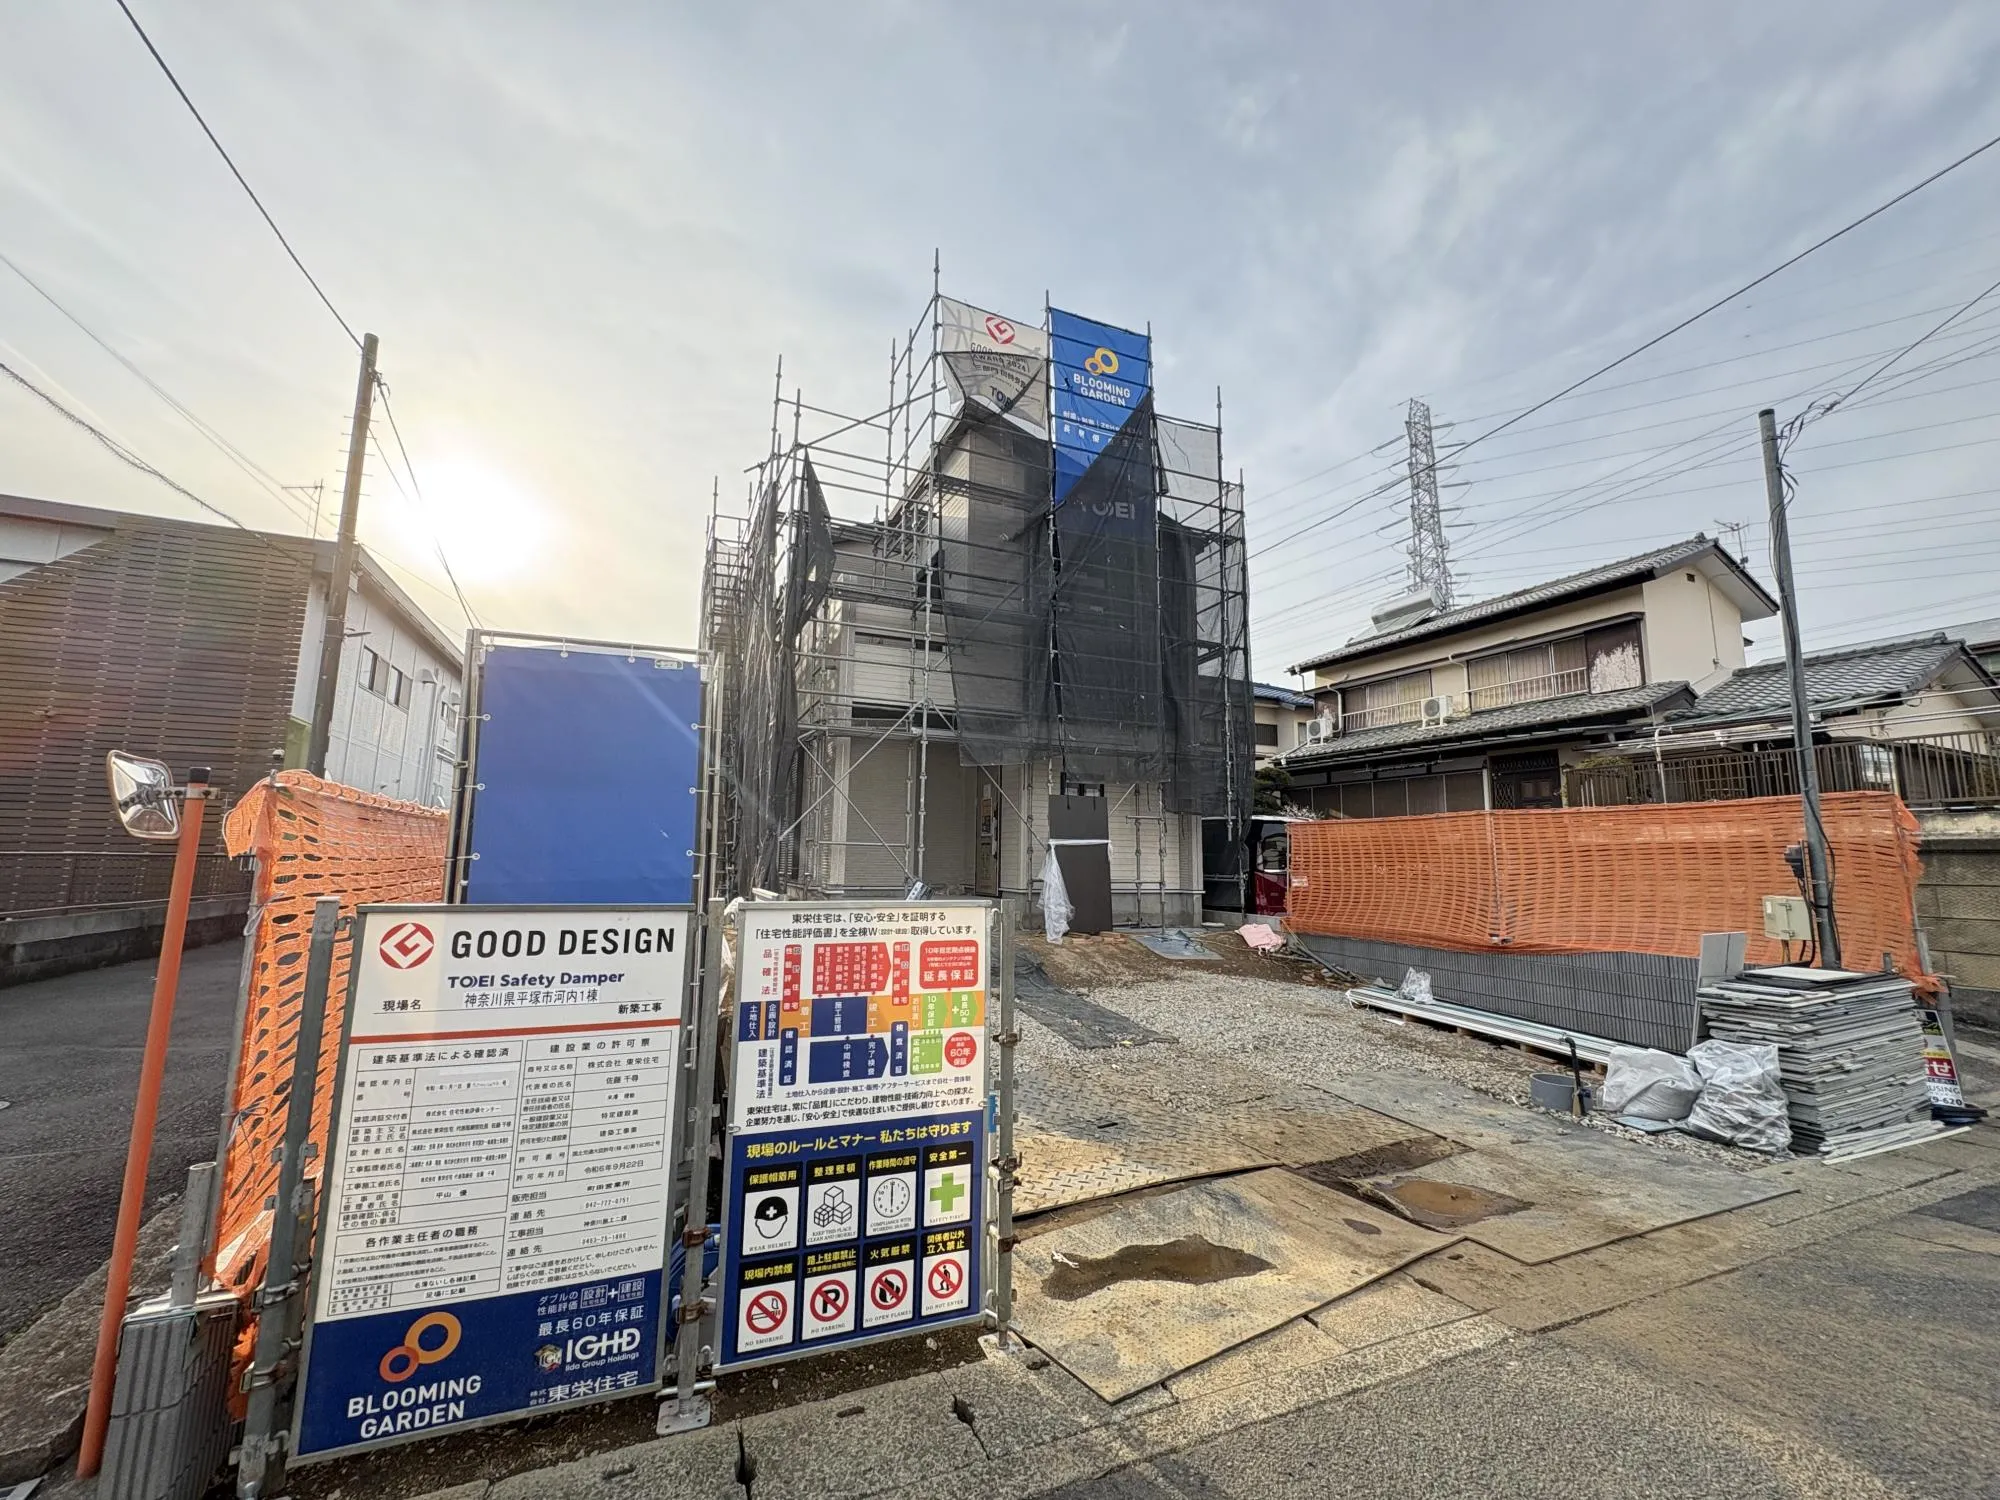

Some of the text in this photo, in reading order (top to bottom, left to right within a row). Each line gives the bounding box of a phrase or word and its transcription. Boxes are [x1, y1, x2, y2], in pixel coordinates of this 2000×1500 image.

[1073, 373, 1130, 398] BLOOMING
[1080, 386, 1126, 407] GARDEN
[452, 928, 675, 958] GOOD DESIGN
[500, 974, 555, 988] Safety
[560, 972, 625, 986] Damper
[761, 949, 772, 995] 品確法
[924, 969, 975, 982] 延長保証
[382, 999, 422, 1011] 現場名
[464, 988, 598, 1008] 神奈川県平塚市河内1棟
[618, 1002, 662, 1014] 新築工事
[748, 1005, 758, 1038] 土地仕入
[372, 1047, 509, 1064] 建築基準法による確認済
[867, 1041, 877, 1076] 完了検査
[895, 1024, 904, 1074] 検査済証
[842, 1043, 852, 1078] 中間検査
[756, 1048, 768, 1099] 建築基準法
[746, 1120, 972, 1158] 現場のルールとマナー 私たちは守ります
[929, 1150, 967, 1162] 安全第一
[813, 1163, 856, 1177] 整理整頓
[366, 1225, 478, 1248] 各作業主任者の職務
[927, 1229, 965, 1244] 関係者以外
[870, 1244, 911, 1260] 火気厳禁
[926, 1240, 965, 1254] 立入禁止
[807, 1248, 856, 1266] 路上駐車禁止
[744, 1263, 793, 1280] 現場内禁煙
[583, 1287, 606, 1300] 設計
[620, 1280, 643, 1294] 建設
[537, 1300, 578, 1316] 性能評価
[538, 1291, 578, 1306] ダブルの
[538, 1305, 644, 1337] 最長60年保証
[566, 1328, 641, 1362] IGHD
[582, 1358, 605, 1369] Group
[607, 1352, 639, 1363] Holdings
[547, 1370, 639, 1402] 東栄住宅
[347, 1374, 482, 1418] BLOOMING
[360, 1400, 465, 1439] GARDEN
